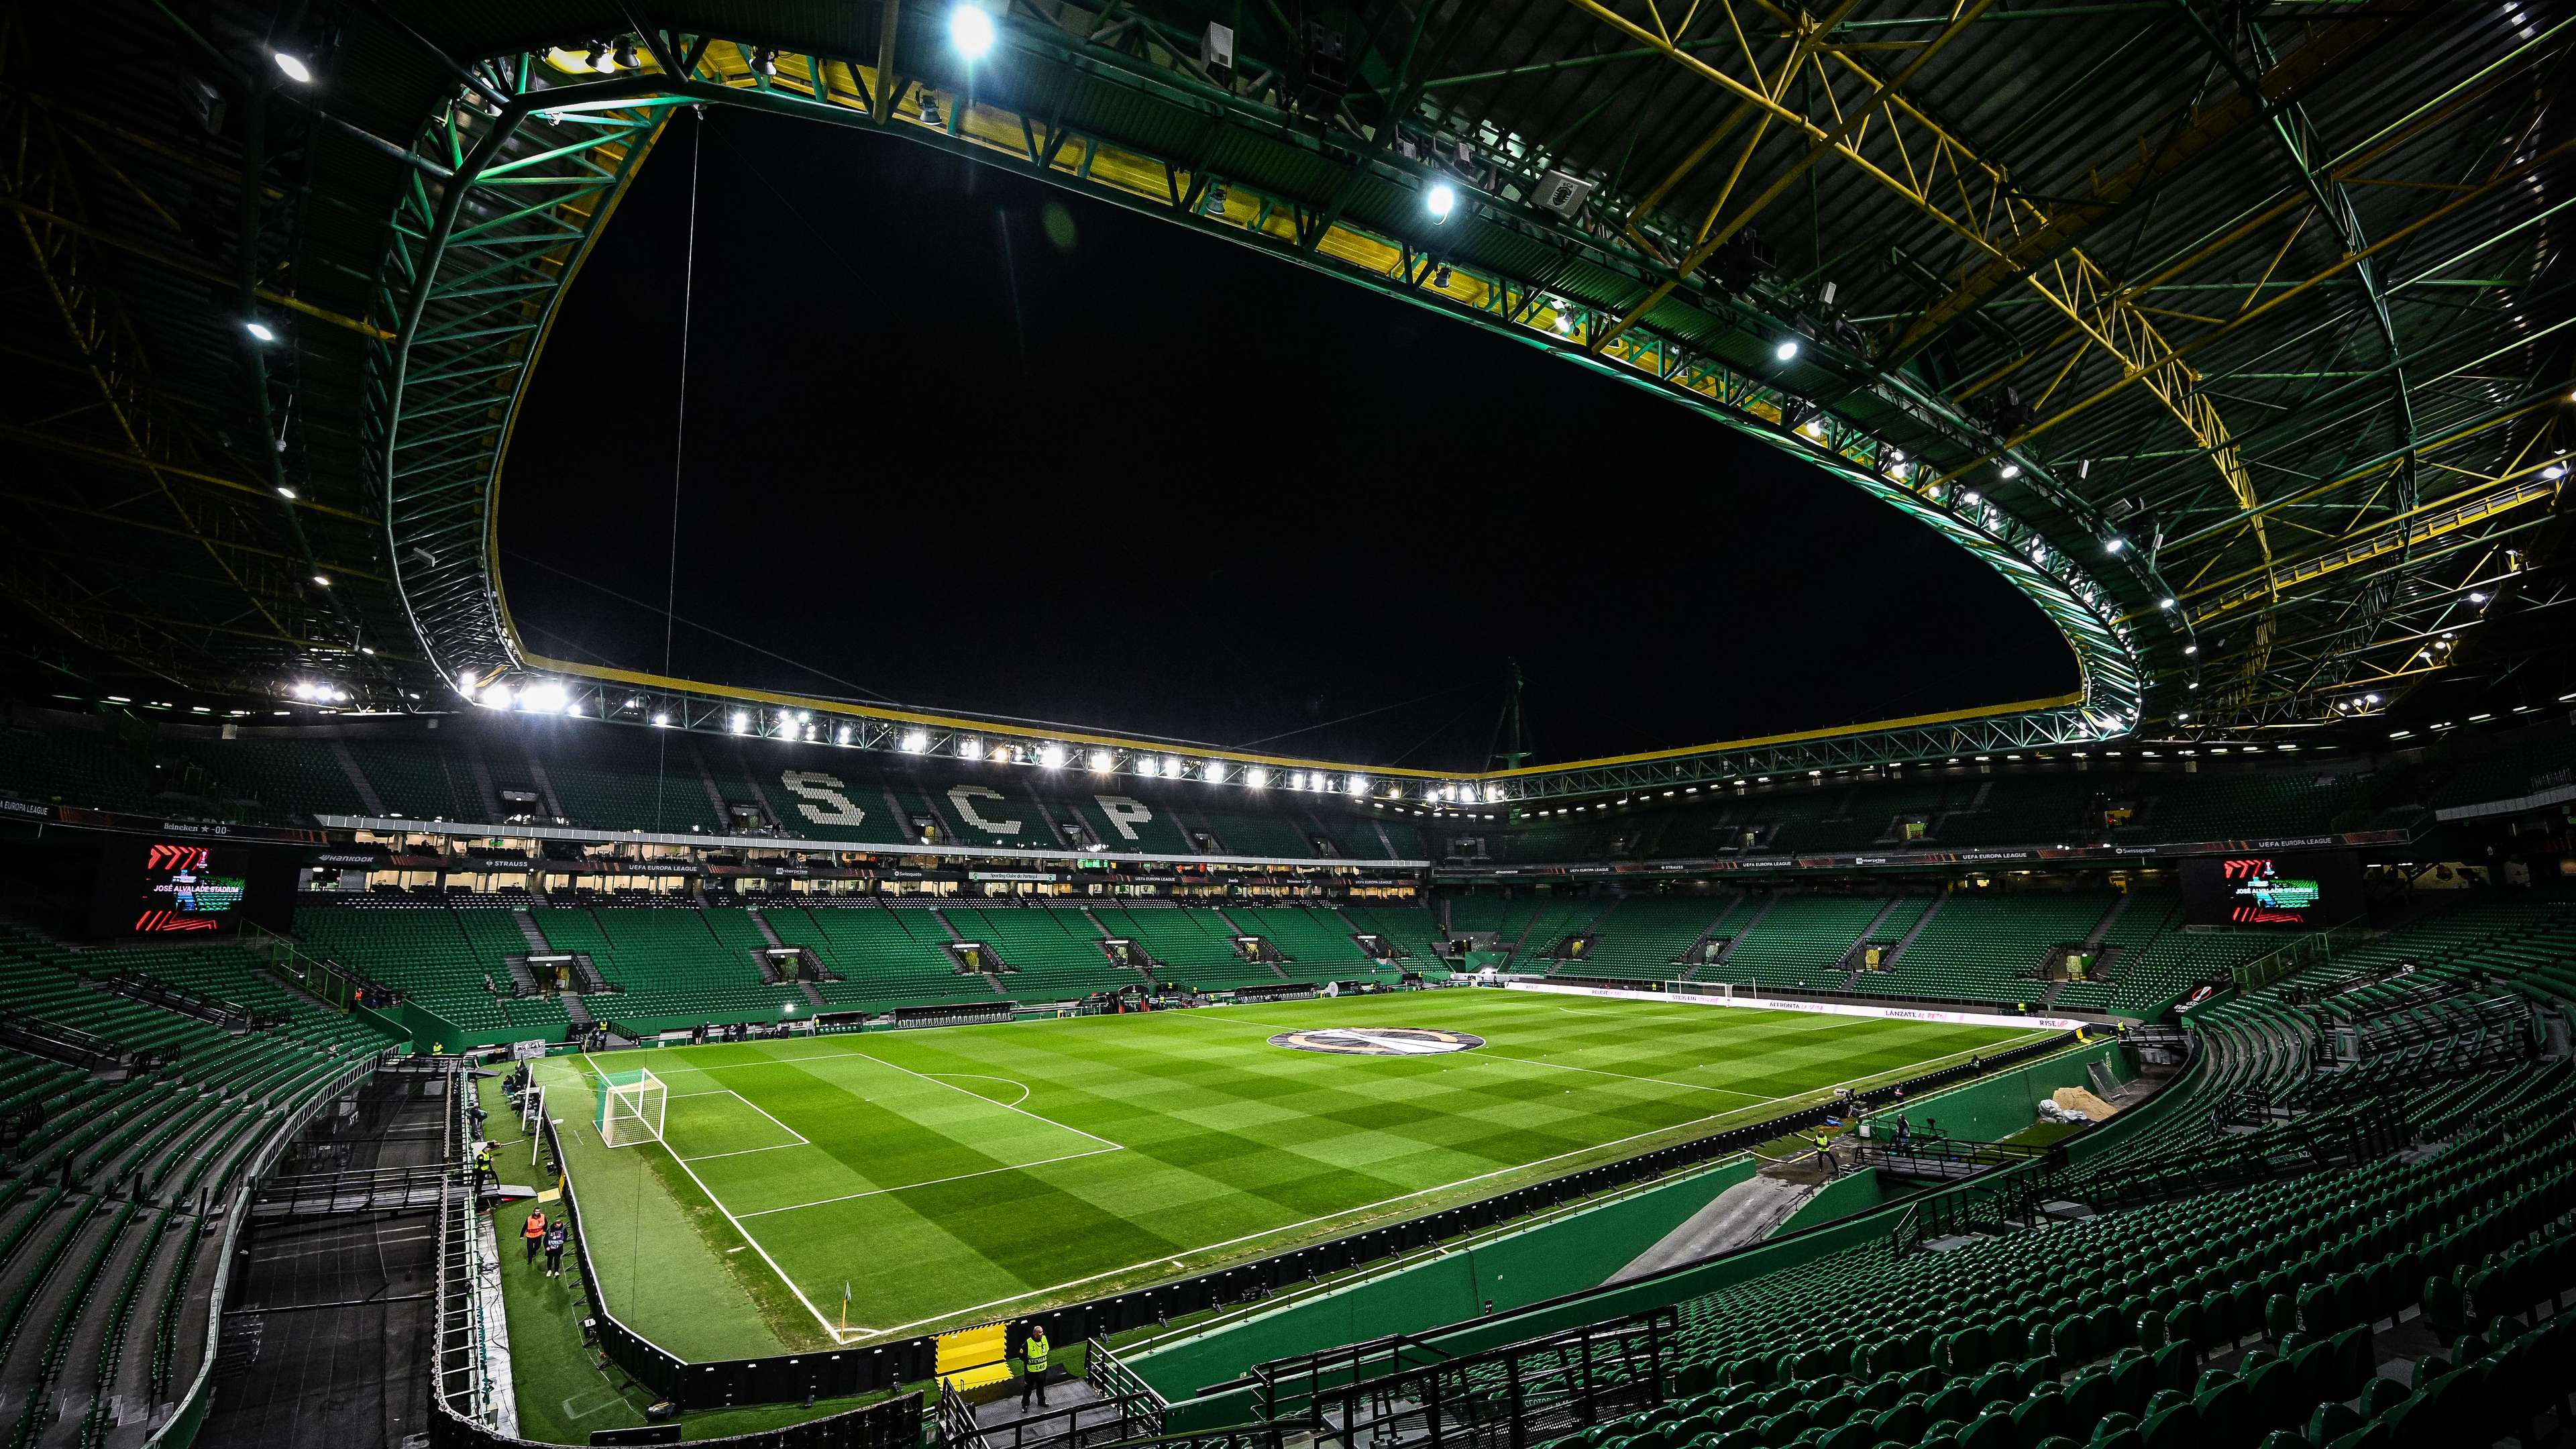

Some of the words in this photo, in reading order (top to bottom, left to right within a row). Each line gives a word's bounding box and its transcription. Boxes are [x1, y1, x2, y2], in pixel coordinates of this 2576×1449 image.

[4, 801, 26, 812] EUROPA
[26, 805, 48, 816] LEAGUE
[164, 822, 198, 832] Heineken
[154, 884, 172, 892] JOSÉ
[1028, 1356, 1047, 1364] STEWAR
